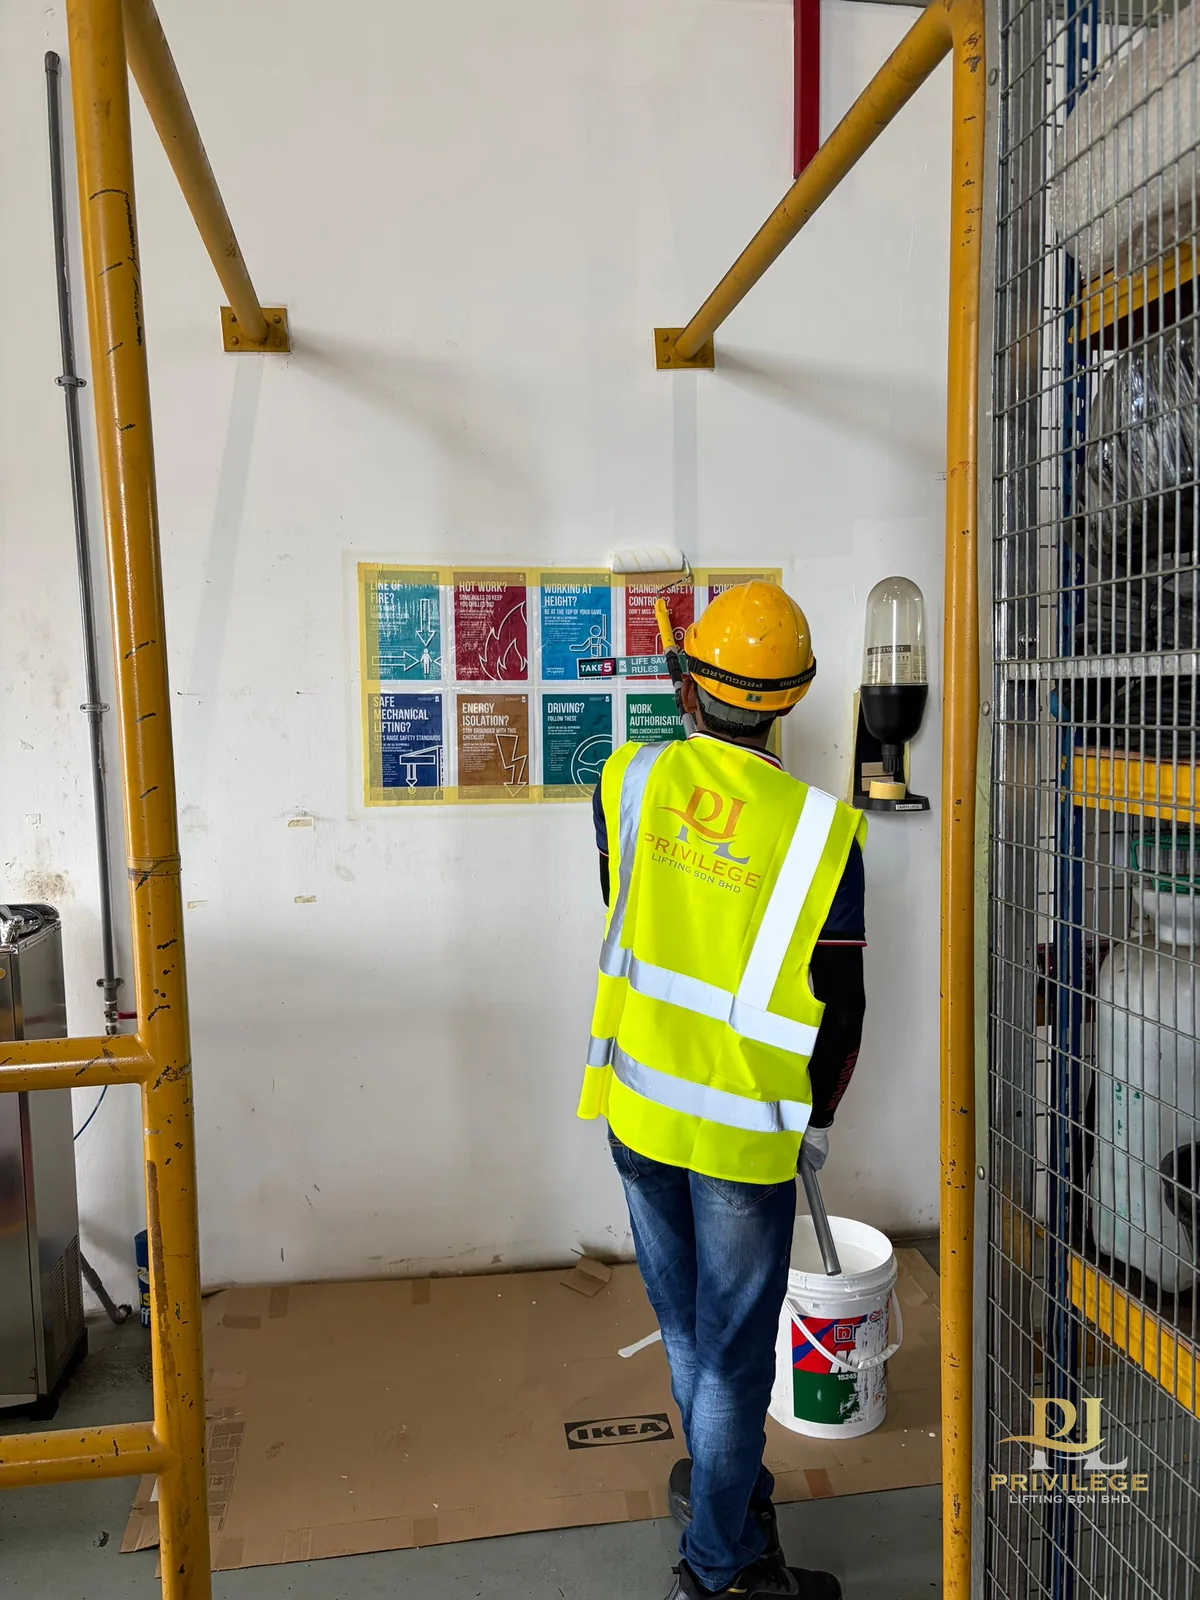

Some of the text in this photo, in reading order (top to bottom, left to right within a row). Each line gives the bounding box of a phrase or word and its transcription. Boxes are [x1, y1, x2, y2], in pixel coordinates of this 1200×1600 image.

[460, 581, 508, 592] HOT WORK?
[544, 584, 592, 594] WORKING AT
[666, 584, 694, 594] SAFETY
[370, 593, 394, 604] FIRE?
[544, 596, 577, 606] HEIGHT?
[632, 666, 658, 674] RULES
[701, 668, 763, 688] PROGUARD
[374, 696, 395, 707] SAFE
[462, 703, 494, 713] ENERGY
[548, 703, 585, 713] DRIVING?
[630, 704, 652, 713] WORK
[374, 709, 429, 720] MECHANICAL
[462, 716, 509, 726] ISOLATION?
[630, 716, 683, 726] AUTHORISATIO
[374, 722, 411, 732] LIFTING?
[644, 833, 761, 889] PRIVILEGE
[652, 854, 740, 893] LIFTING SDN BHD
[577, 1422, 664, 1440] IKEA
